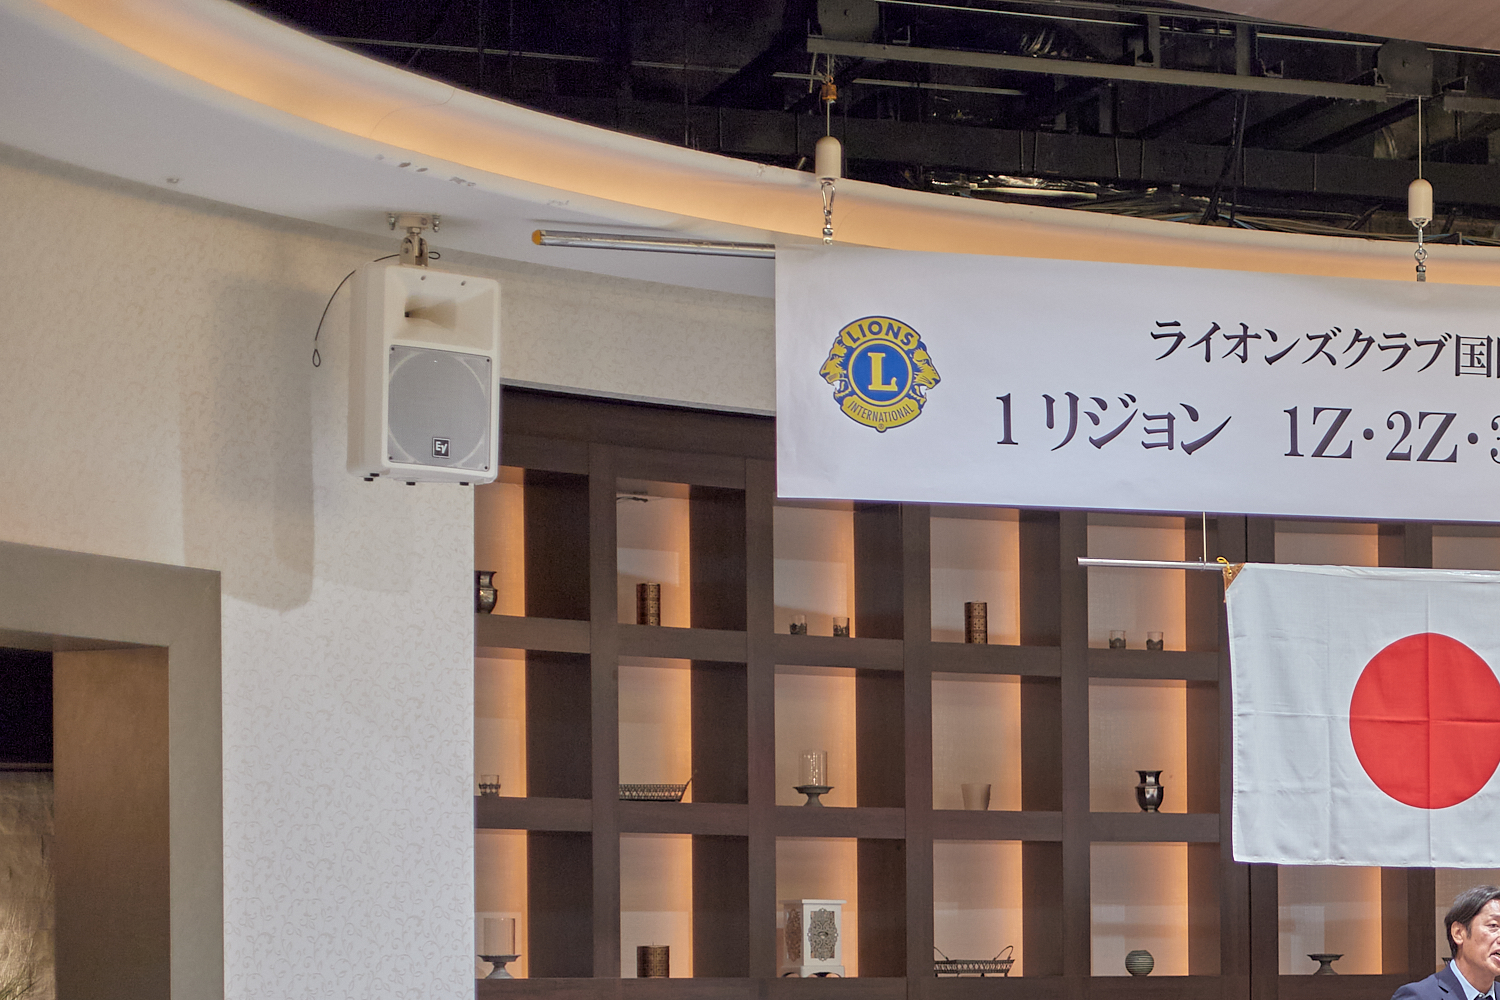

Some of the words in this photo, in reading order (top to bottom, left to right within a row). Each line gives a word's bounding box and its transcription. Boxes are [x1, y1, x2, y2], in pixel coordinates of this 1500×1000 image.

[846, 320, 914, 347] LIONS
[867, 352, 898, 391] L
[847, 400, 915, 423] INTERNATIONAL
